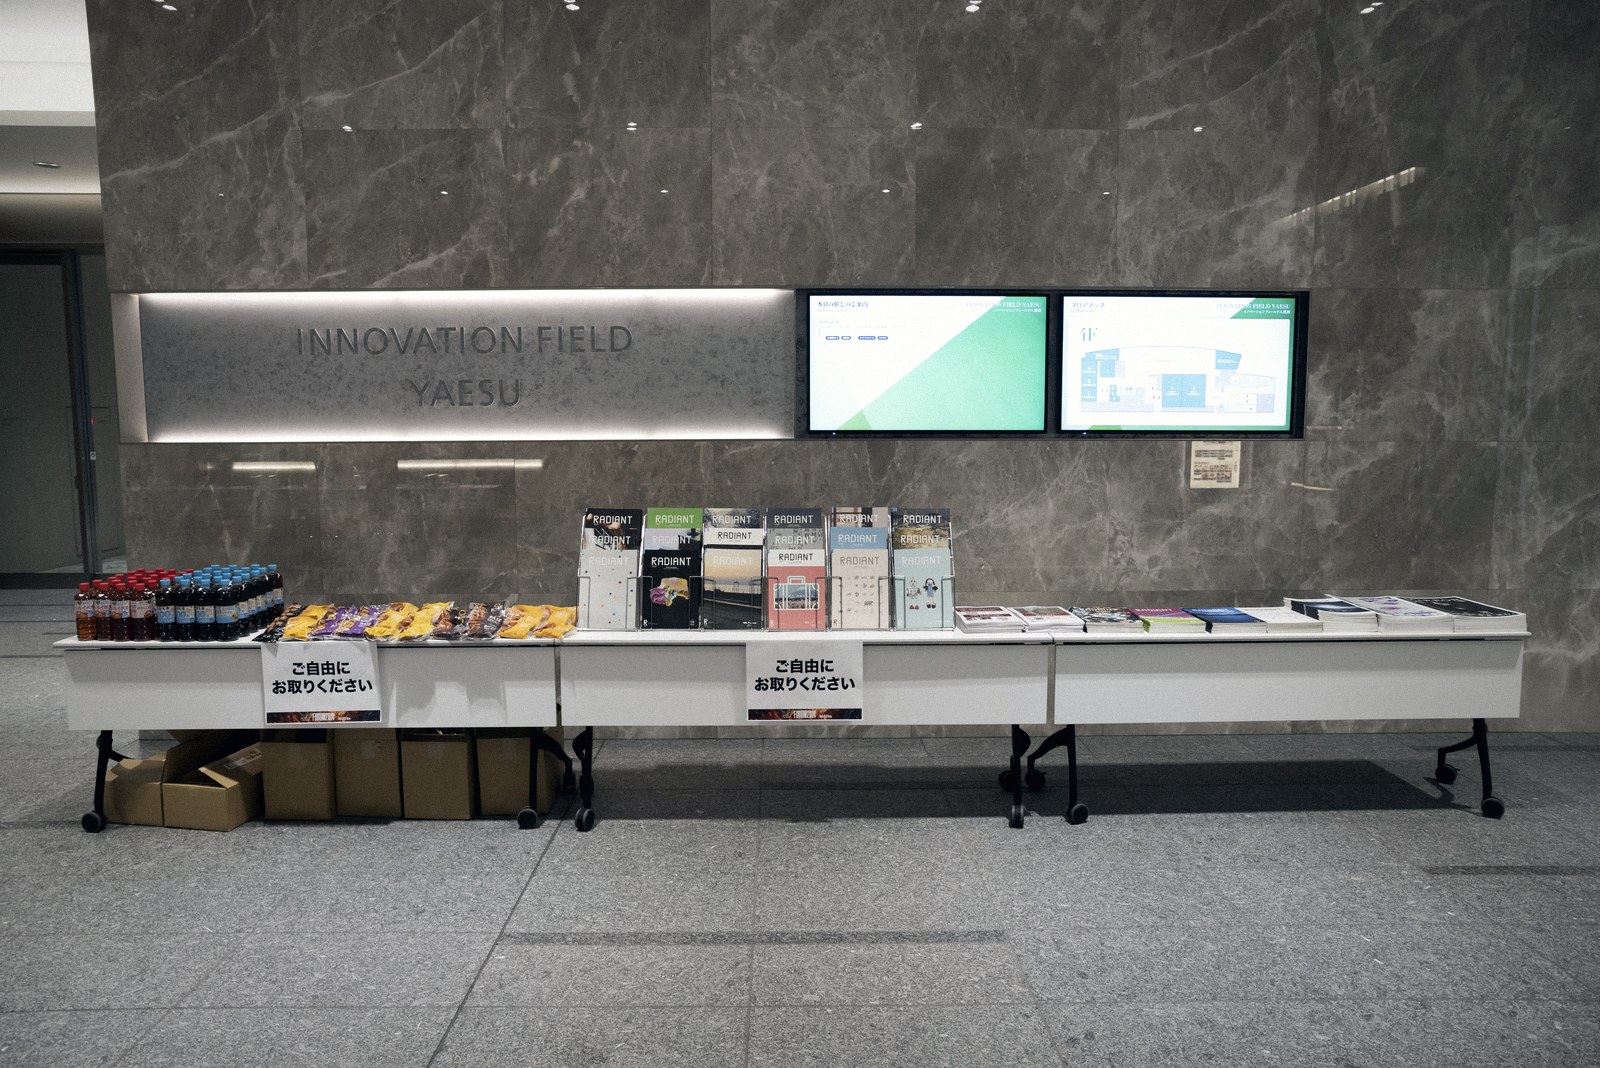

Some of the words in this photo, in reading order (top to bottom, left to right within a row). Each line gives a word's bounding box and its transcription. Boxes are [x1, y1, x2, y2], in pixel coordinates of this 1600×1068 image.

[297, 326, 523, 356] INNOVATION
[537, 325, 633, 353] FIELD
[409, 379, 522, 408] YAESU
[593, 515, 633, 525] RADIANT
[655, 514, 695, 524] RADIANT
[712, 515, 752, 524] RADIANT
[774, 514, 814, 524] RADIANT
[839, 514, 879, 523] RADIANT
[902, 514, 942, 524] RADIANT
[592, 535, 631, 545] RADIANT
[652, 535, 692, 544] RADIANT
[717, 531, 752, 540] RADIANT
[775, 535, 815, 545] RADIANT
[838, 534, 878, 544] RADIANT
[900, 534, 940, 544] RADIANT
[589, 556, 630, 566] RADIANT
[651, 556, 692, 566] RADIANT
[713, 556, 753, 565] RADIANT
[778, 553, 813, 561] RADIANT
[840, 556, 880, 565] RADIANT
[902, 555, 942, 565] RADIANT
[292, 661, 351, 676] ご自由に
[775, 659, 834, 674] ご自由に
[271, 679, 373, 695] お取りください
[754, 676, 856, 692] お取りください
